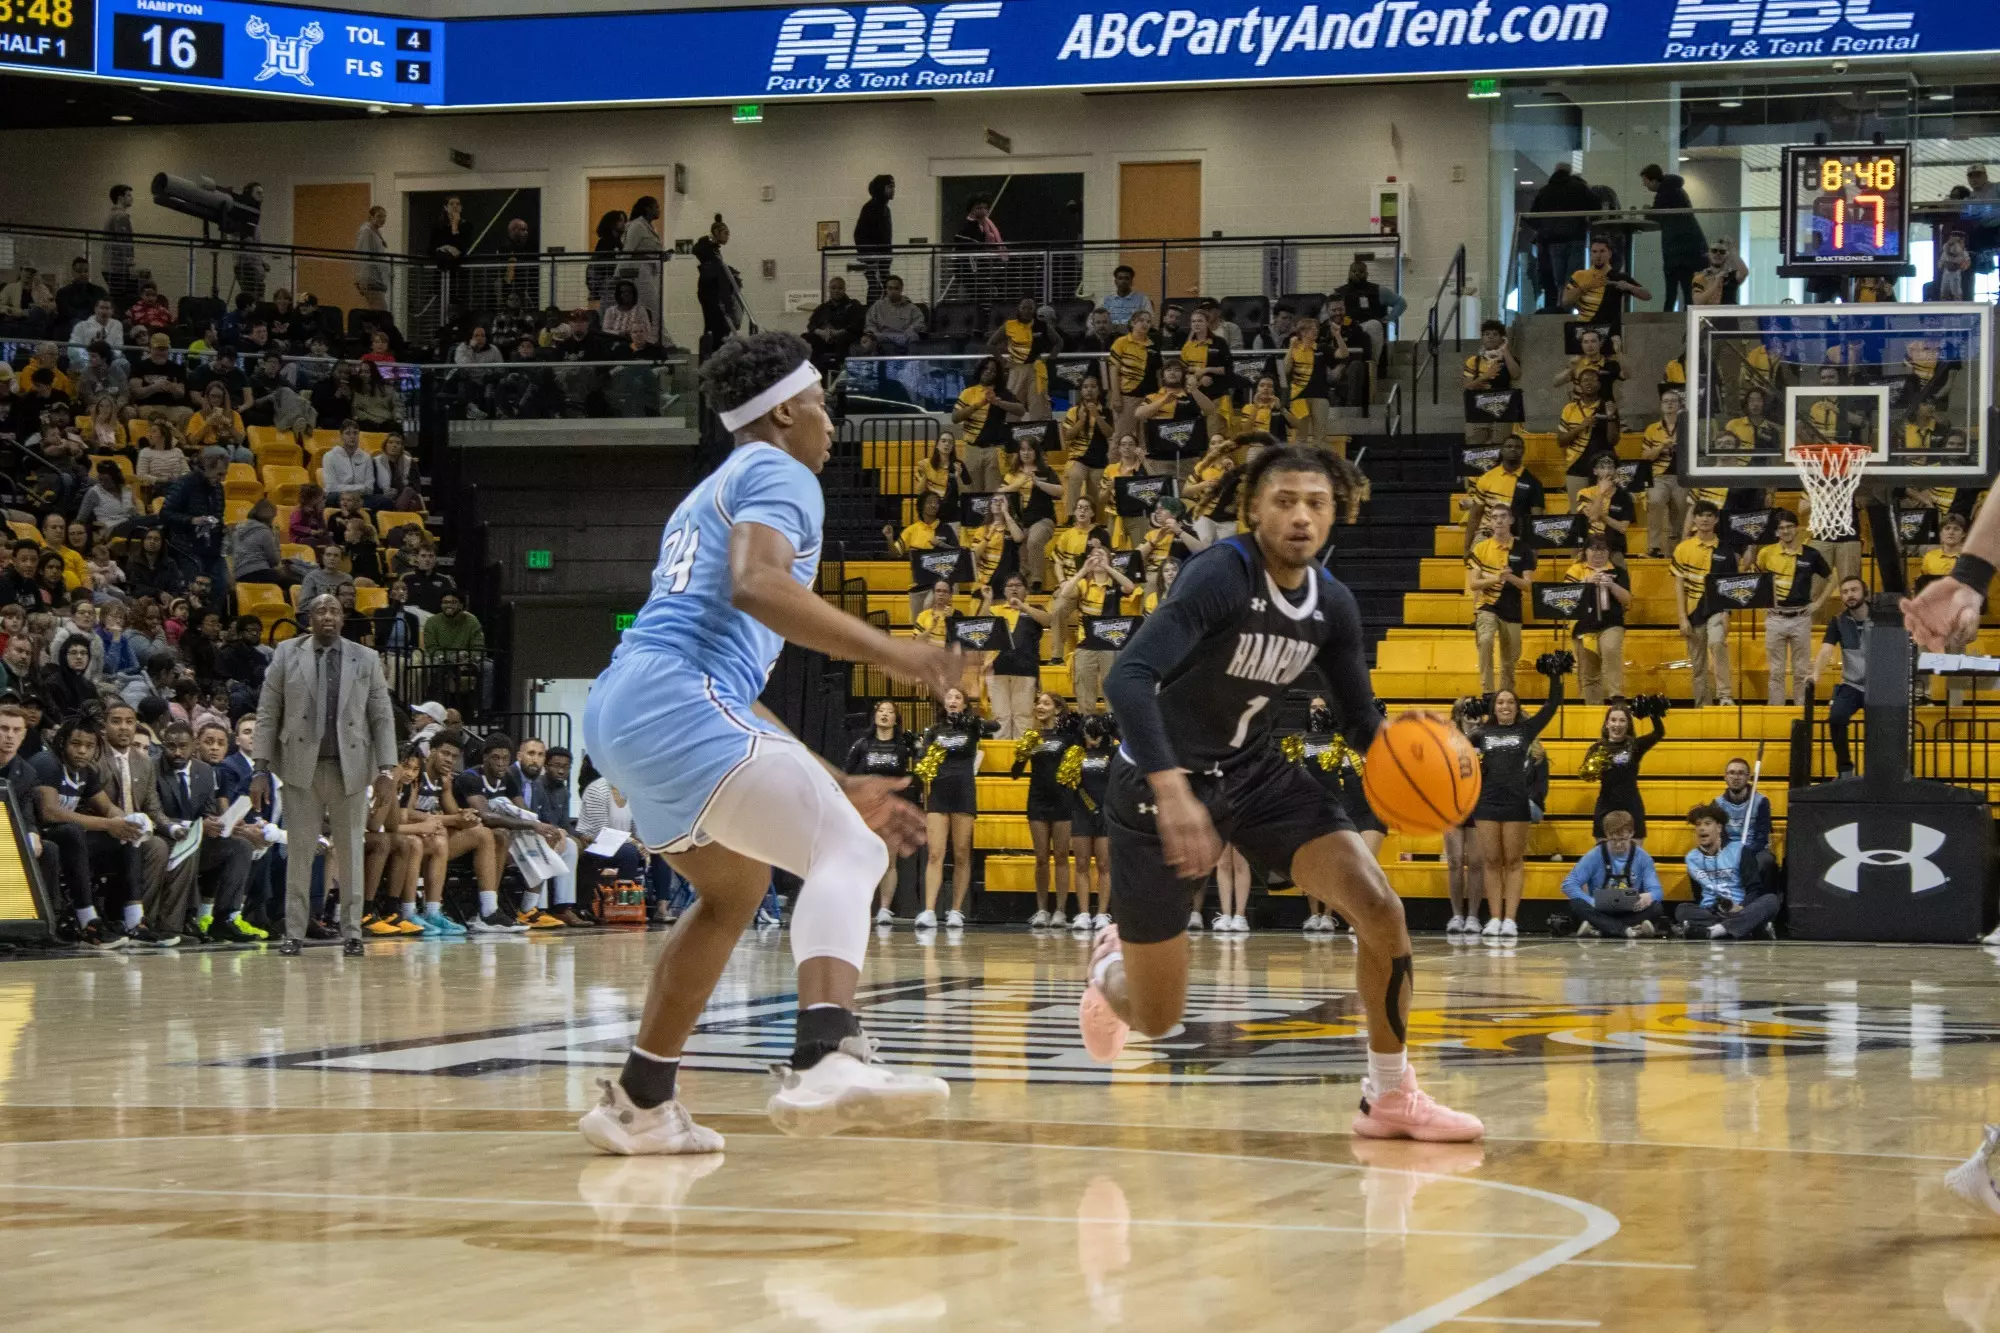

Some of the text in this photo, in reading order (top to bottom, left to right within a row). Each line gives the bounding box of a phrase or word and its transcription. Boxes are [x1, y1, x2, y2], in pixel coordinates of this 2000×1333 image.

[137, 0, 204, 16] HAMPTON
[0, 33, 66, 58] HALF 1
[345, 25, 421, 49] TOL 4
[769, 2, 1001, 72] ABC
[1057, 0, 1609, 67] ABCPartyAndTent.com
[142, 24, 198, 69] 16
[1663, 33, 1920, 60] Party & Tent Rental
[345, 58, 420, 81] FLS 5
[766, 68, 995, 93] Party & Tent Rental
[1822, 159, 1896, 191] 8:48
[1833, 195, 1885, 249] 17
[1532, 519, 1574, 532] TOWSON
[529, 551, 551, 567] EXIT
[1542, 588, 1584, 602] TOWSON
[1717, 578, 1760, 592] TOWSON
[1225, 632, 1320, 684] HAMP
[1229, 695, 1270, 748] 1
